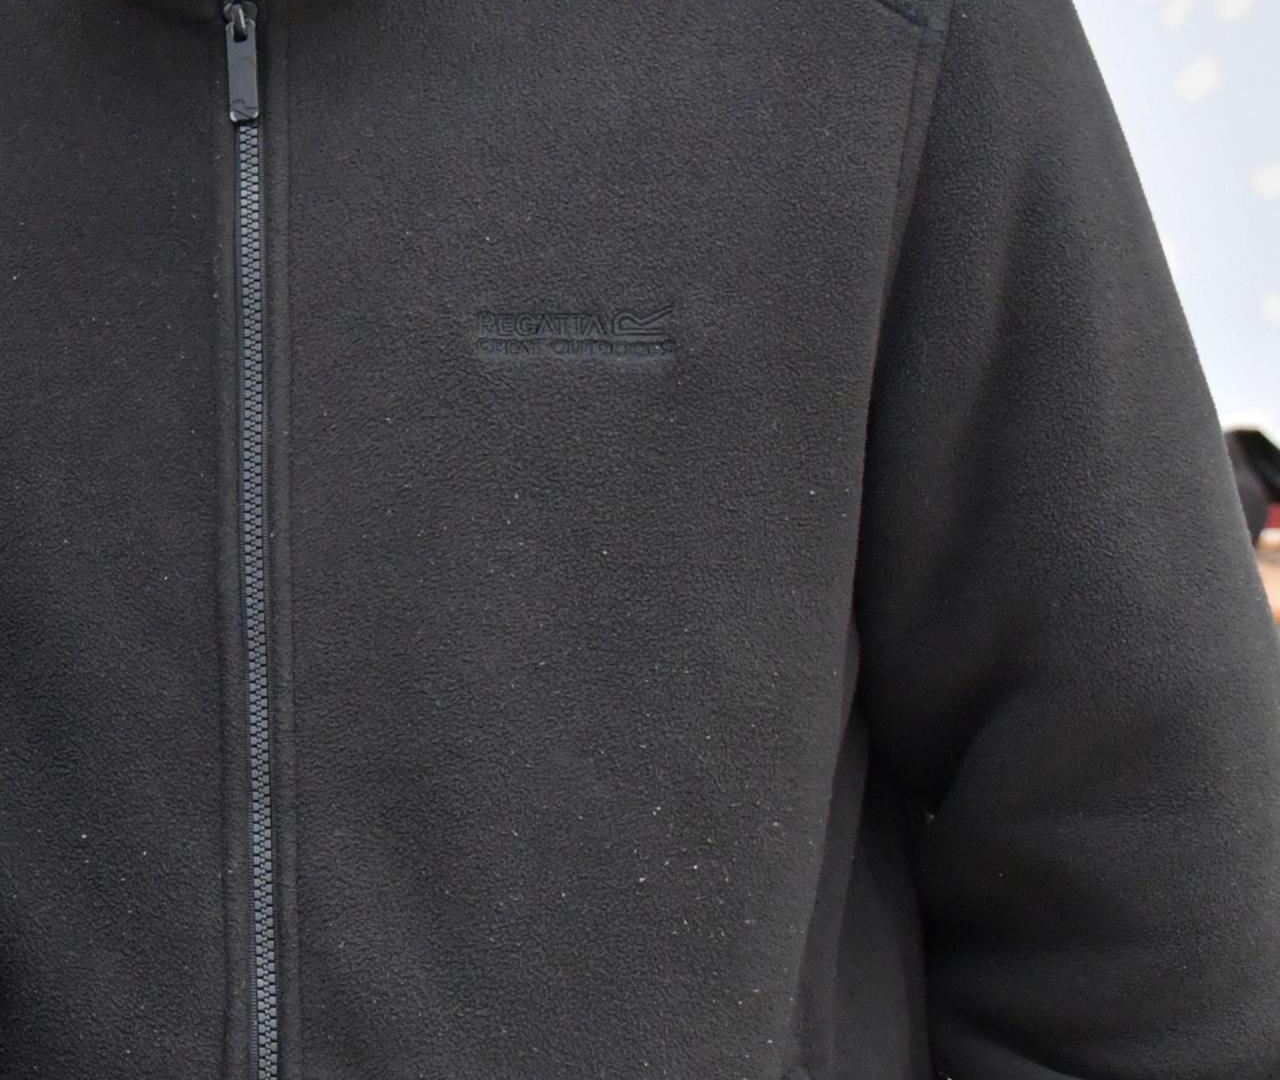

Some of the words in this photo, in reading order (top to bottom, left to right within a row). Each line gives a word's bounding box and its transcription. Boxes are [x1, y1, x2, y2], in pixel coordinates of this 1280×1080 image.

[477, 310, 608, 337] REGATTA
[477, 338, 541, 355] GREAT
[550, 339, 674, 357] OUTDOORS
